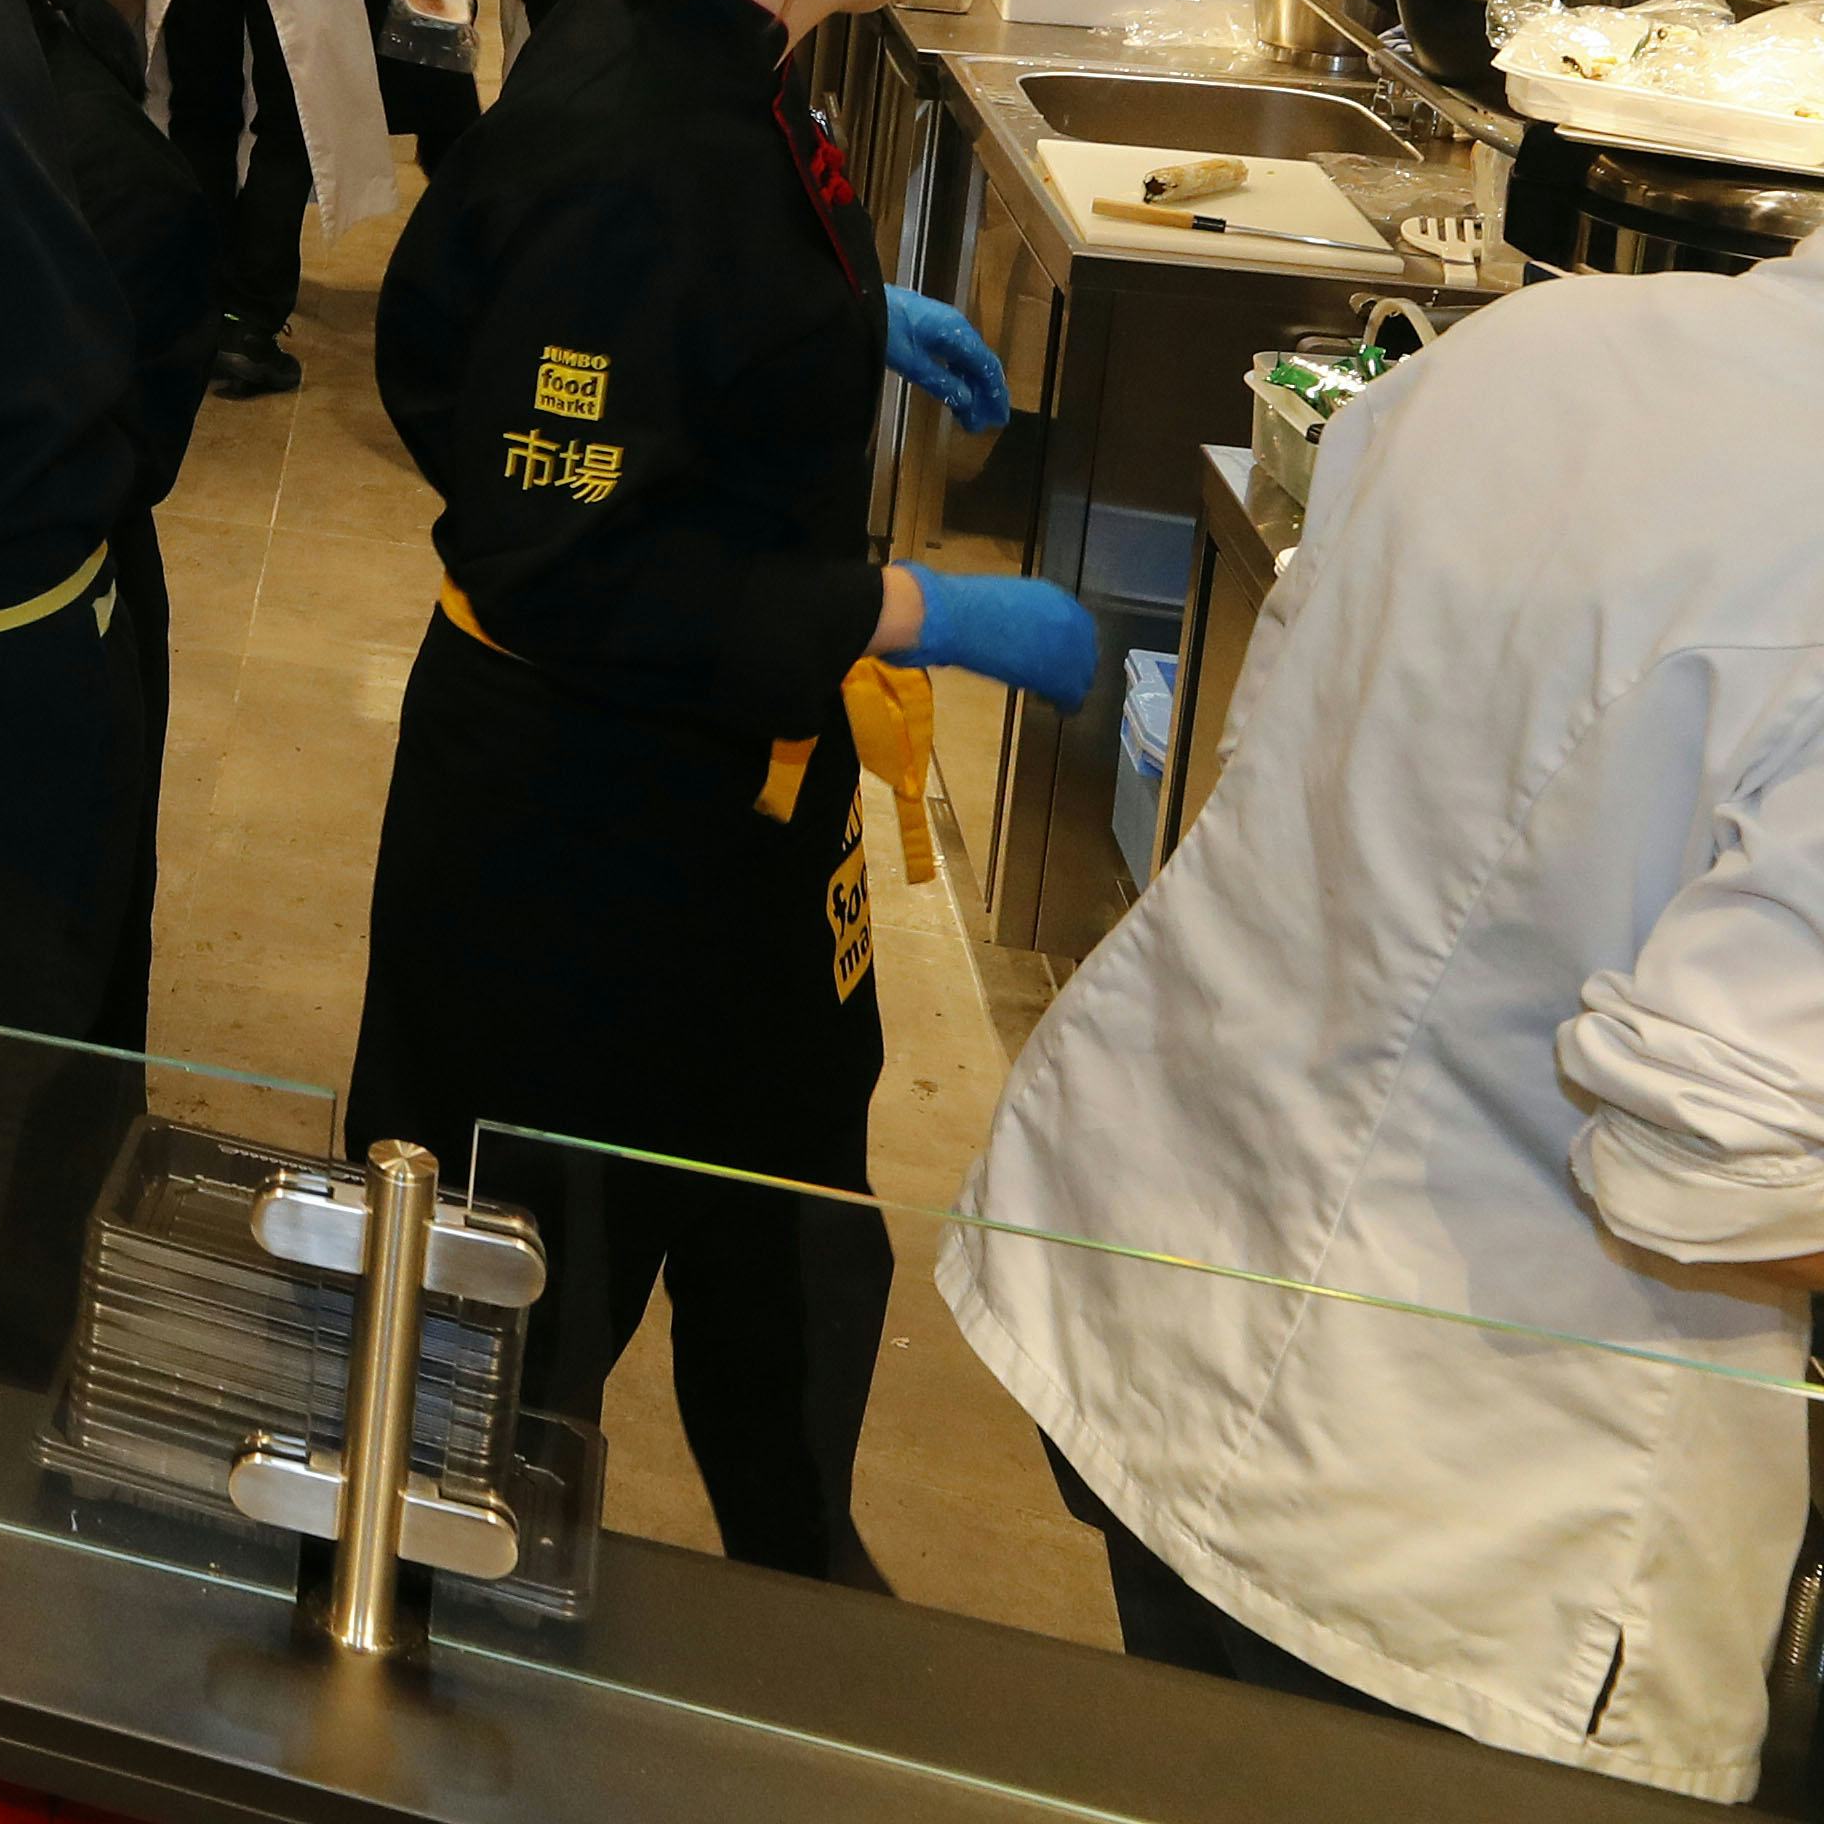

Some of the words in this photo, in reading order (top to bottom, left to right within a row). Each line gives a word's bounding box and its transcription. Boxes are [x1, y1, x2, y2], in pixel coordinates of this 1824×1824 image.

[540, 345, 610, 370] JUMBO
[541, 368, 598, 398] food
[540, 393, 597, 416] markt
[503, 429, 624, 504] 市場
